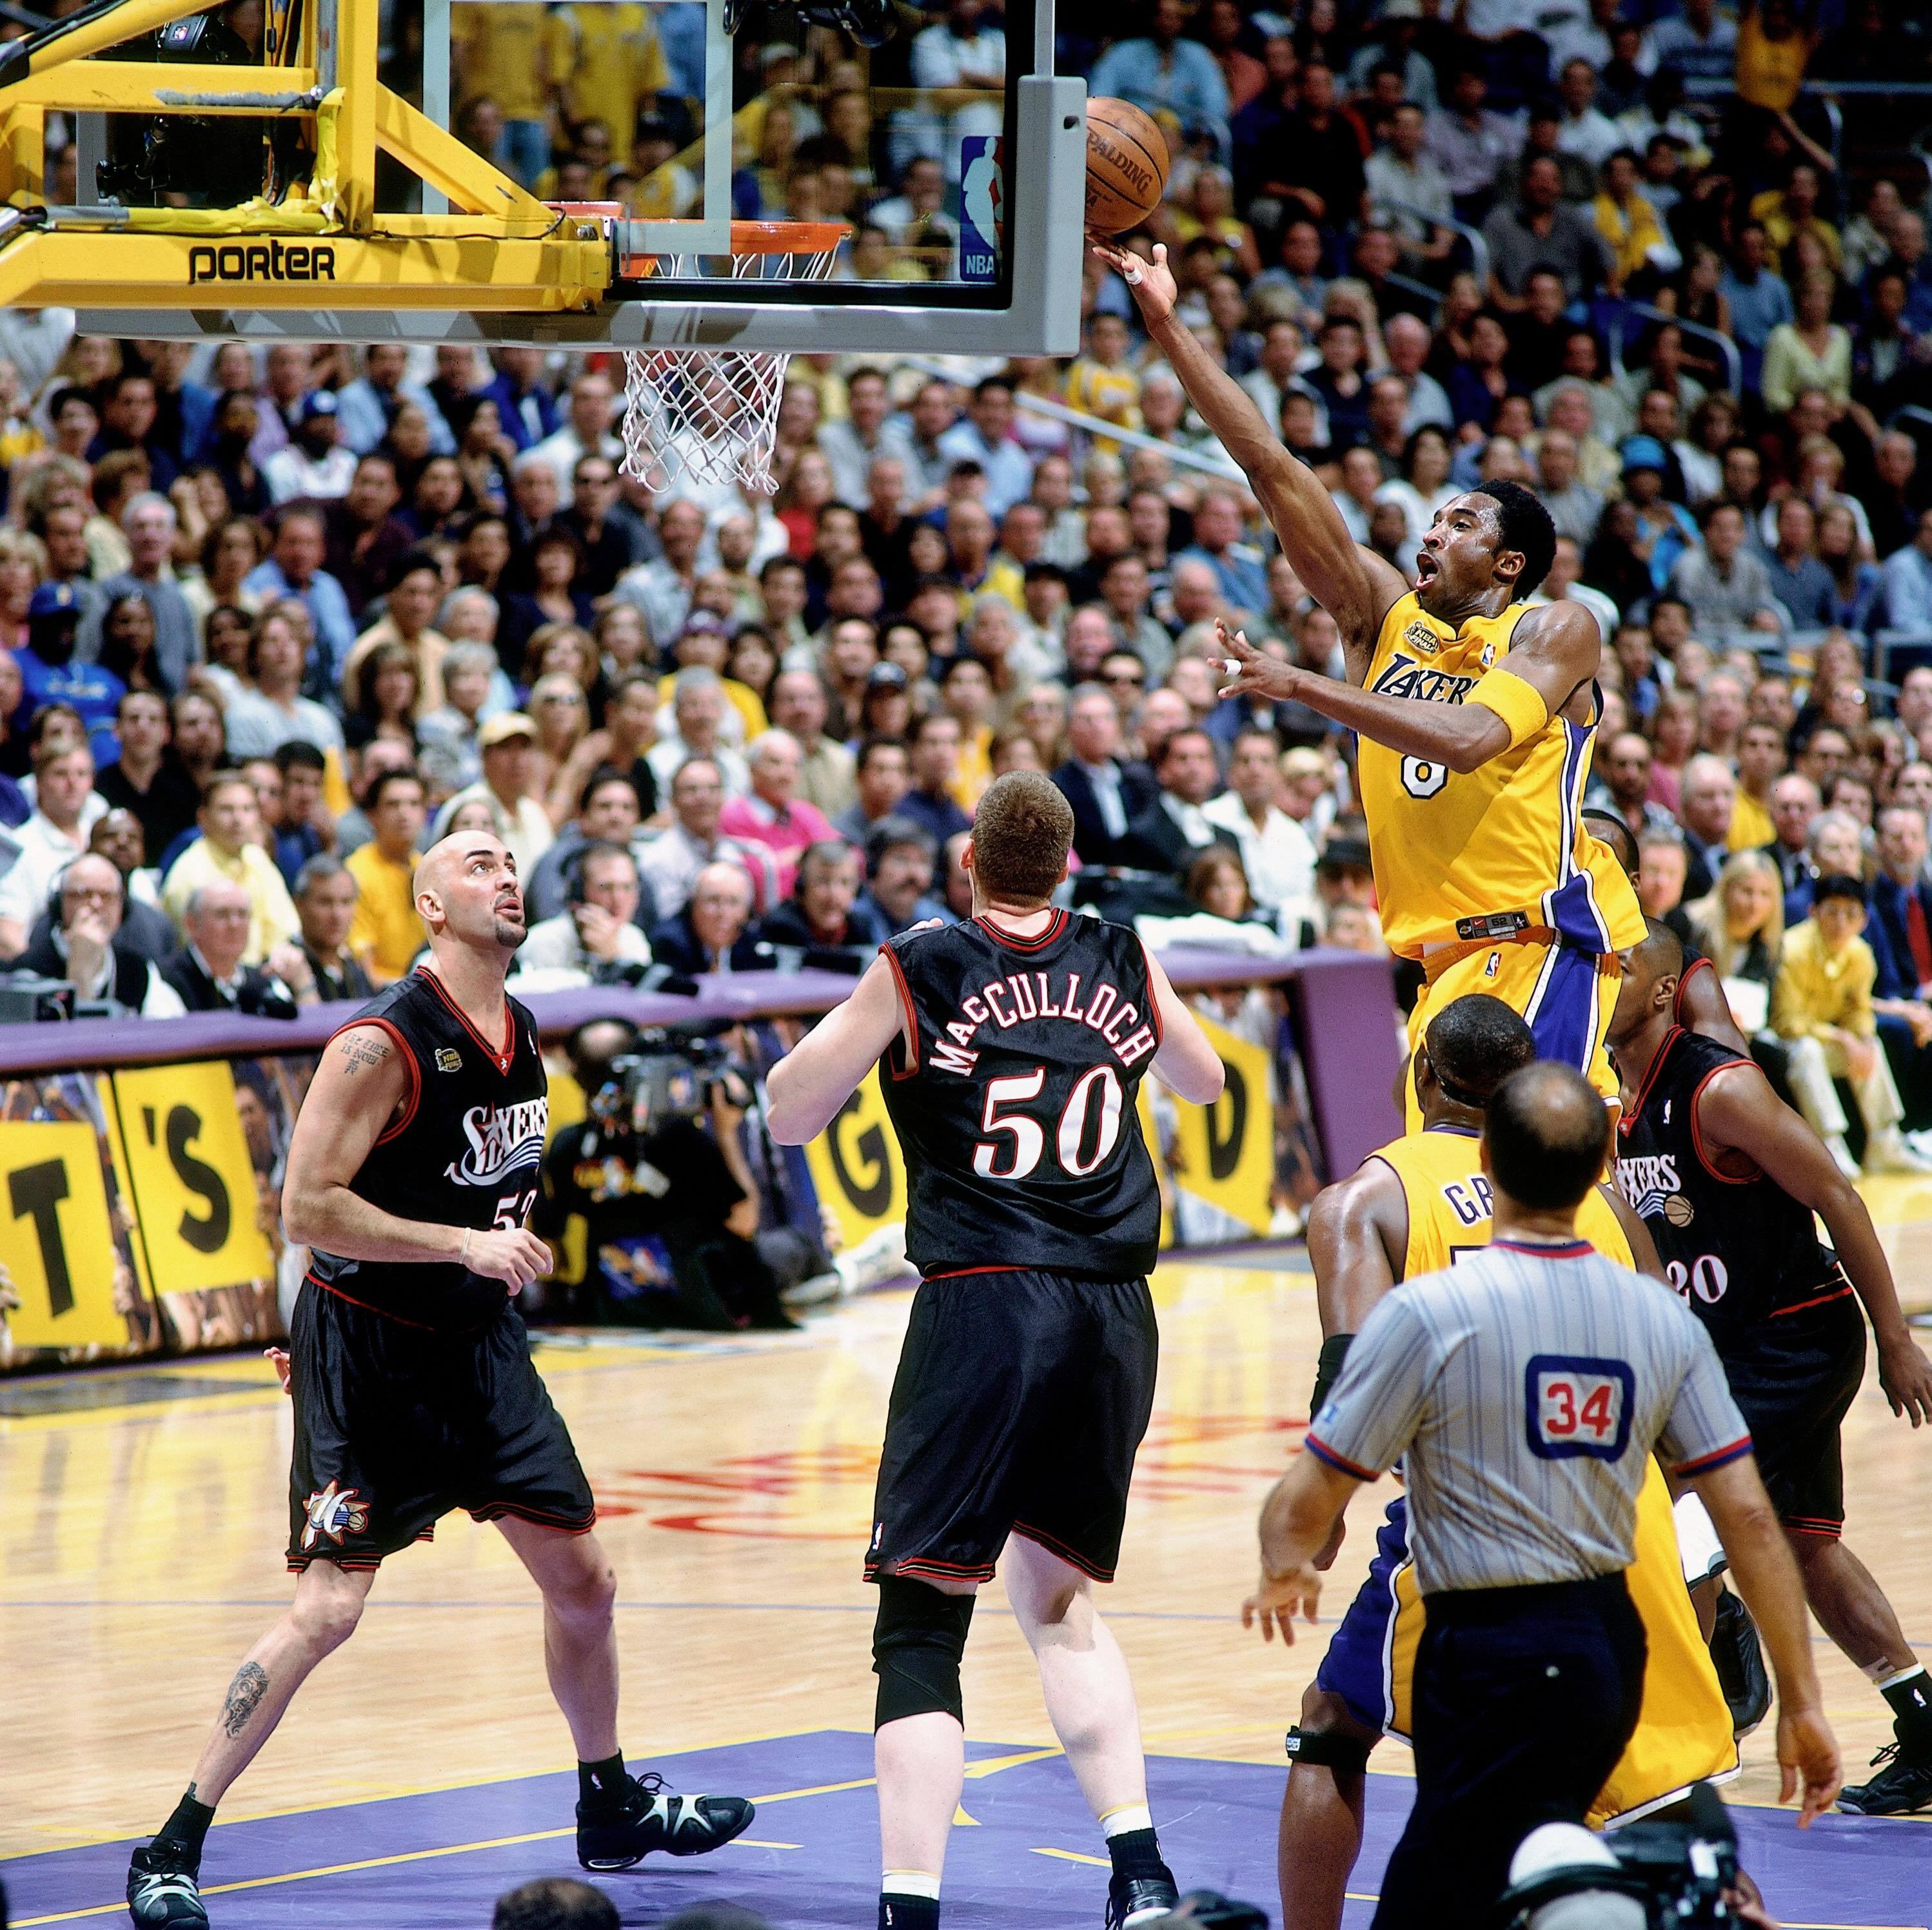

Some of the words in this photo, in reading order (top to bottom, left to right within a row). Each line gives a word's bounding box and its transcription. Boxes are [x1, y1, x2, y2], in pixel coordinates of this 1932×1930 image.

[966, 254, 995, 275] NBA
[1410, 635, 1436, 654] FINALS
[1415, 629, 1437, 647] NBA
[1371, 653, 1481, 705] LAKER
[972, 1063, 1124, 1180] 50
[1666, 1254, 1729, 1307] 20
[1546, 1381, 1612, 1438] 34
